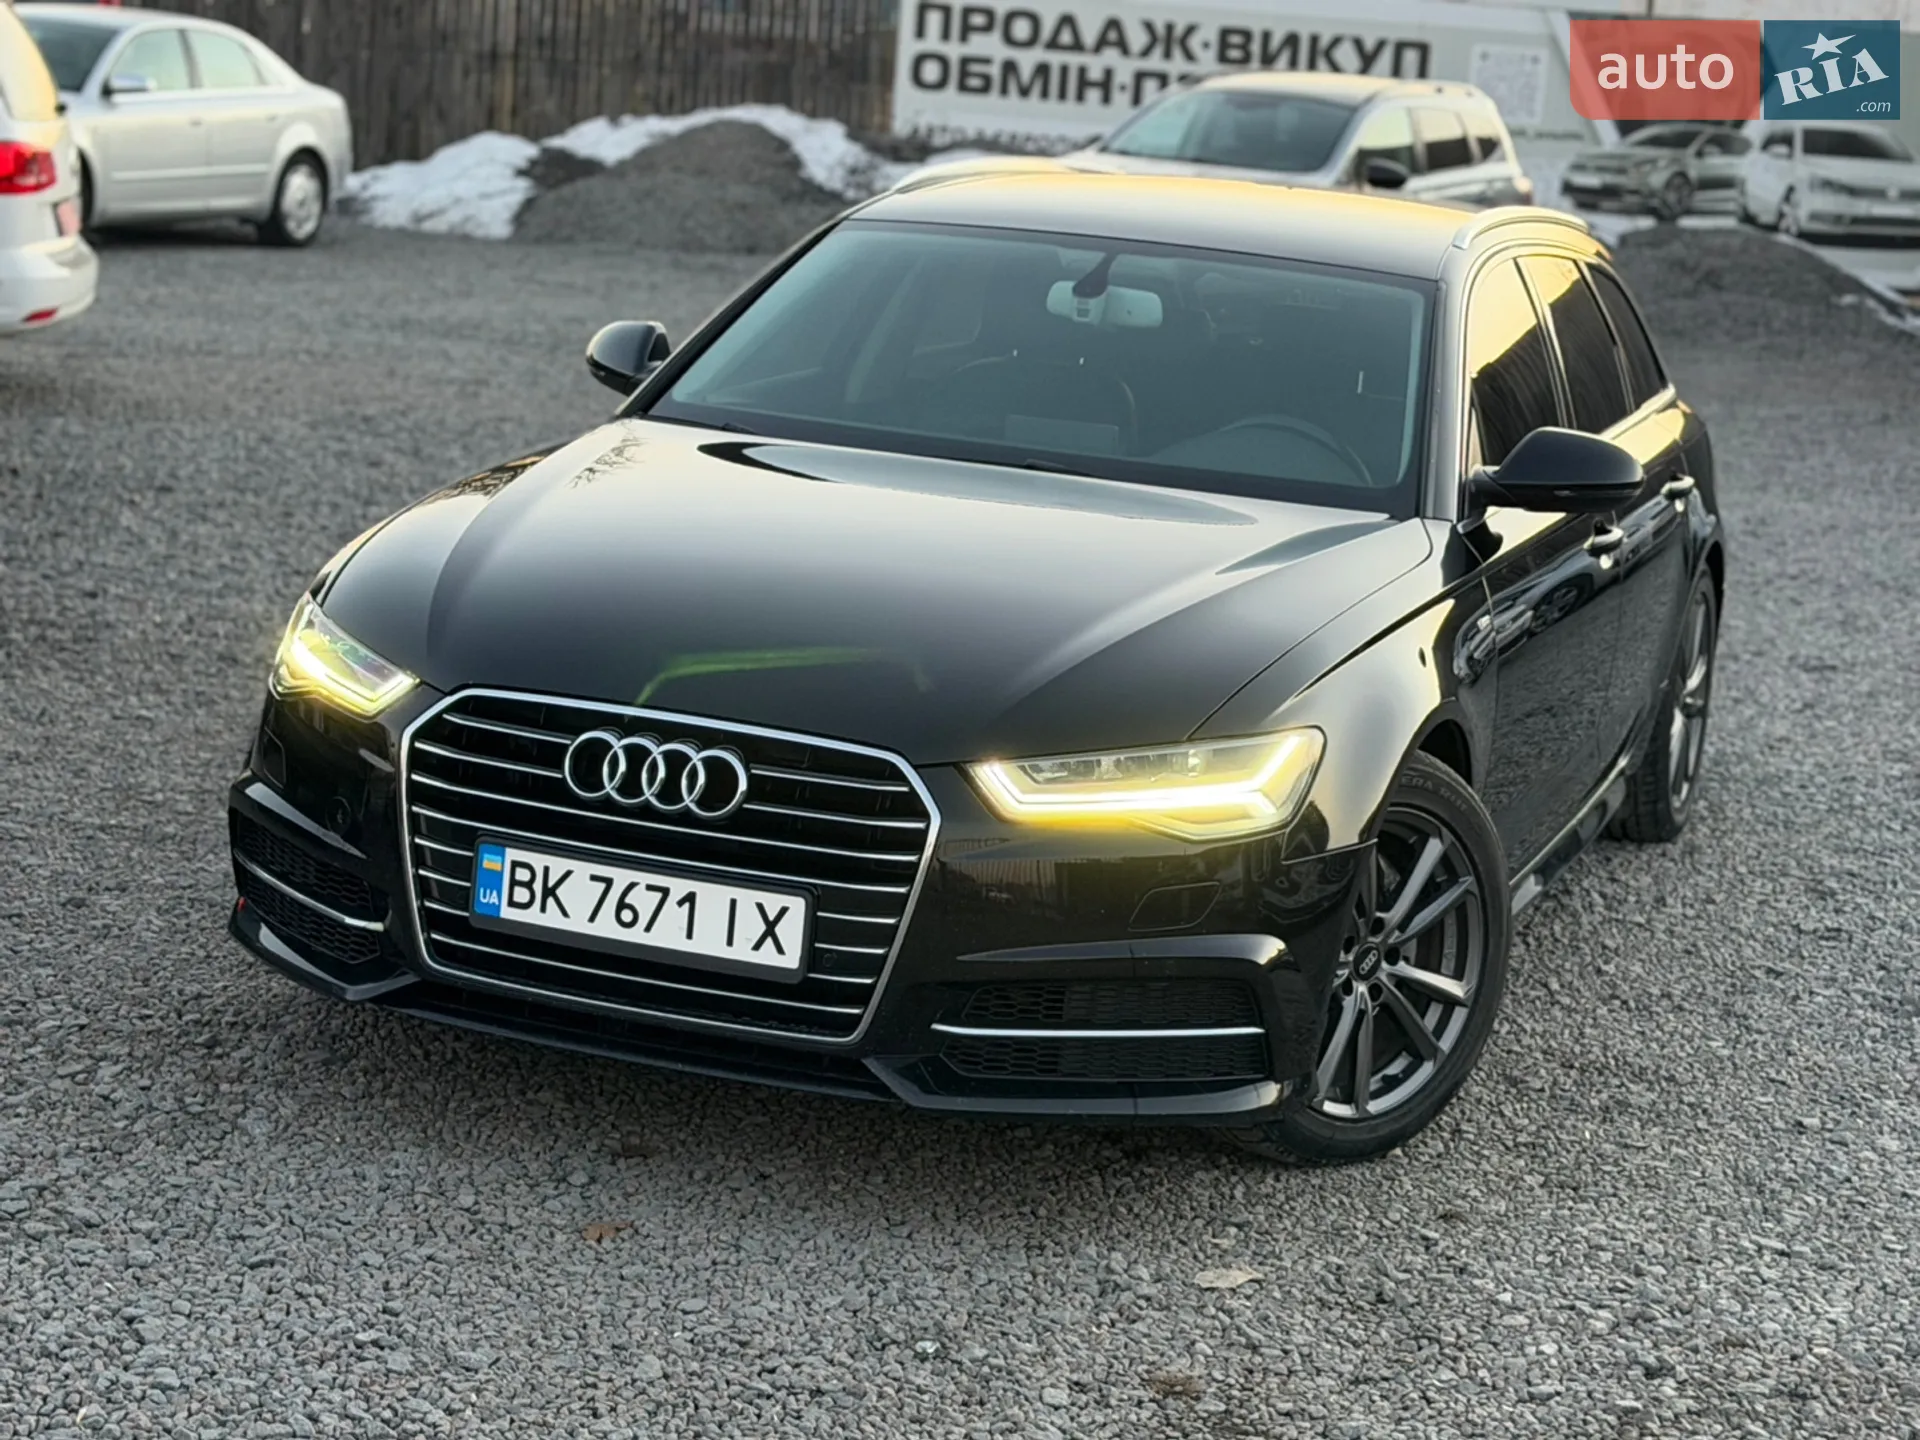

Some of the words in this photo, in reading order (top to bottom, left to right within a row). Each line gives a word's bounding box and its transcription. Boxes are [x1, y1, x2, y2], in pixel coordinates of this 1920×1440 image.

[480, 887, 499, 905] UA
[507, 860, 575, 919] BK
[587, 874, 699, 940] 7671
[726, 897, 790, 956] IX
